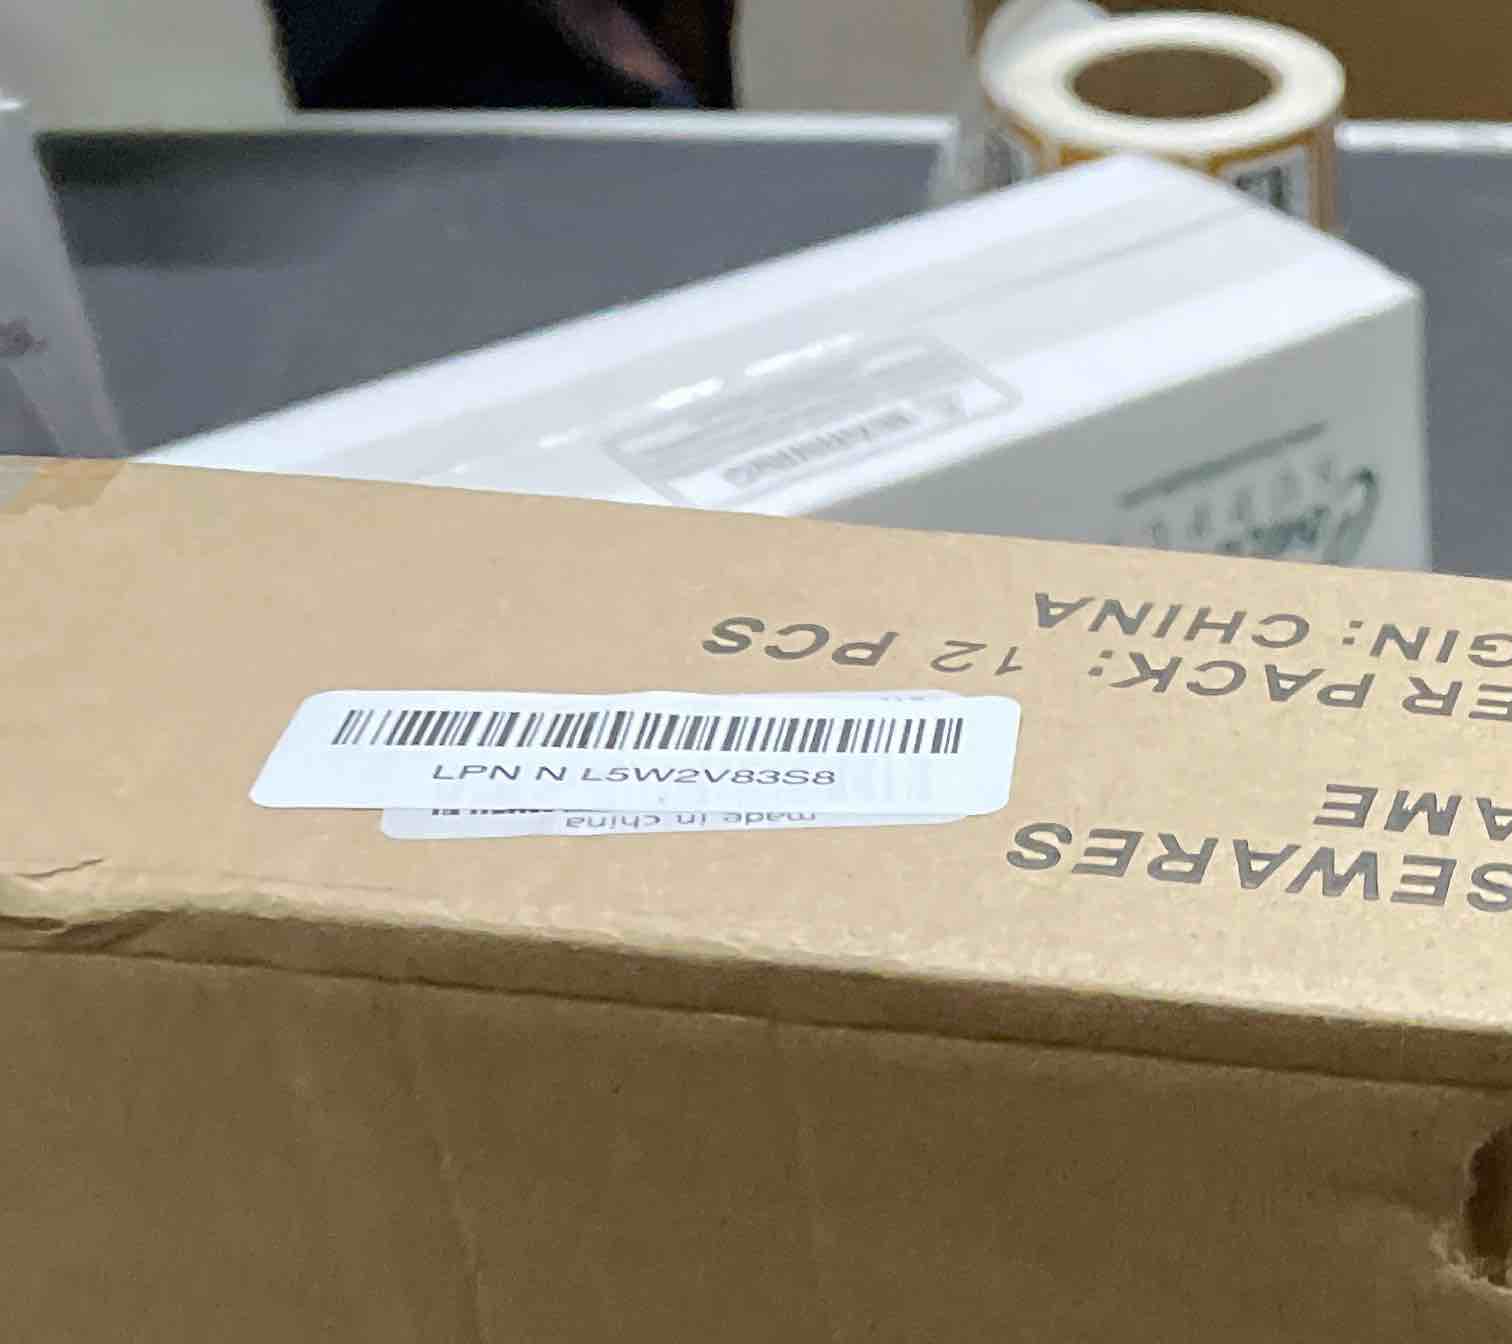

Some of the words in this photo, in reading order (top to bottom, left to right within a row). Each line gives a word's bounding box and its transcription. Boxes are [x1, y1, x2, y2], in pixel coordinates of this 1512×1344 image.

[1034, 592, 1310, 649] CHINA
[702, 617, 900, 667] PCS
[930, 640, 1023, 676] 12
[1087, 650, 1376, 709] PACK:
[565, 812, 661, 830] china
[677, 811, 706, 827] in
[724, 811, 816, 825] made
